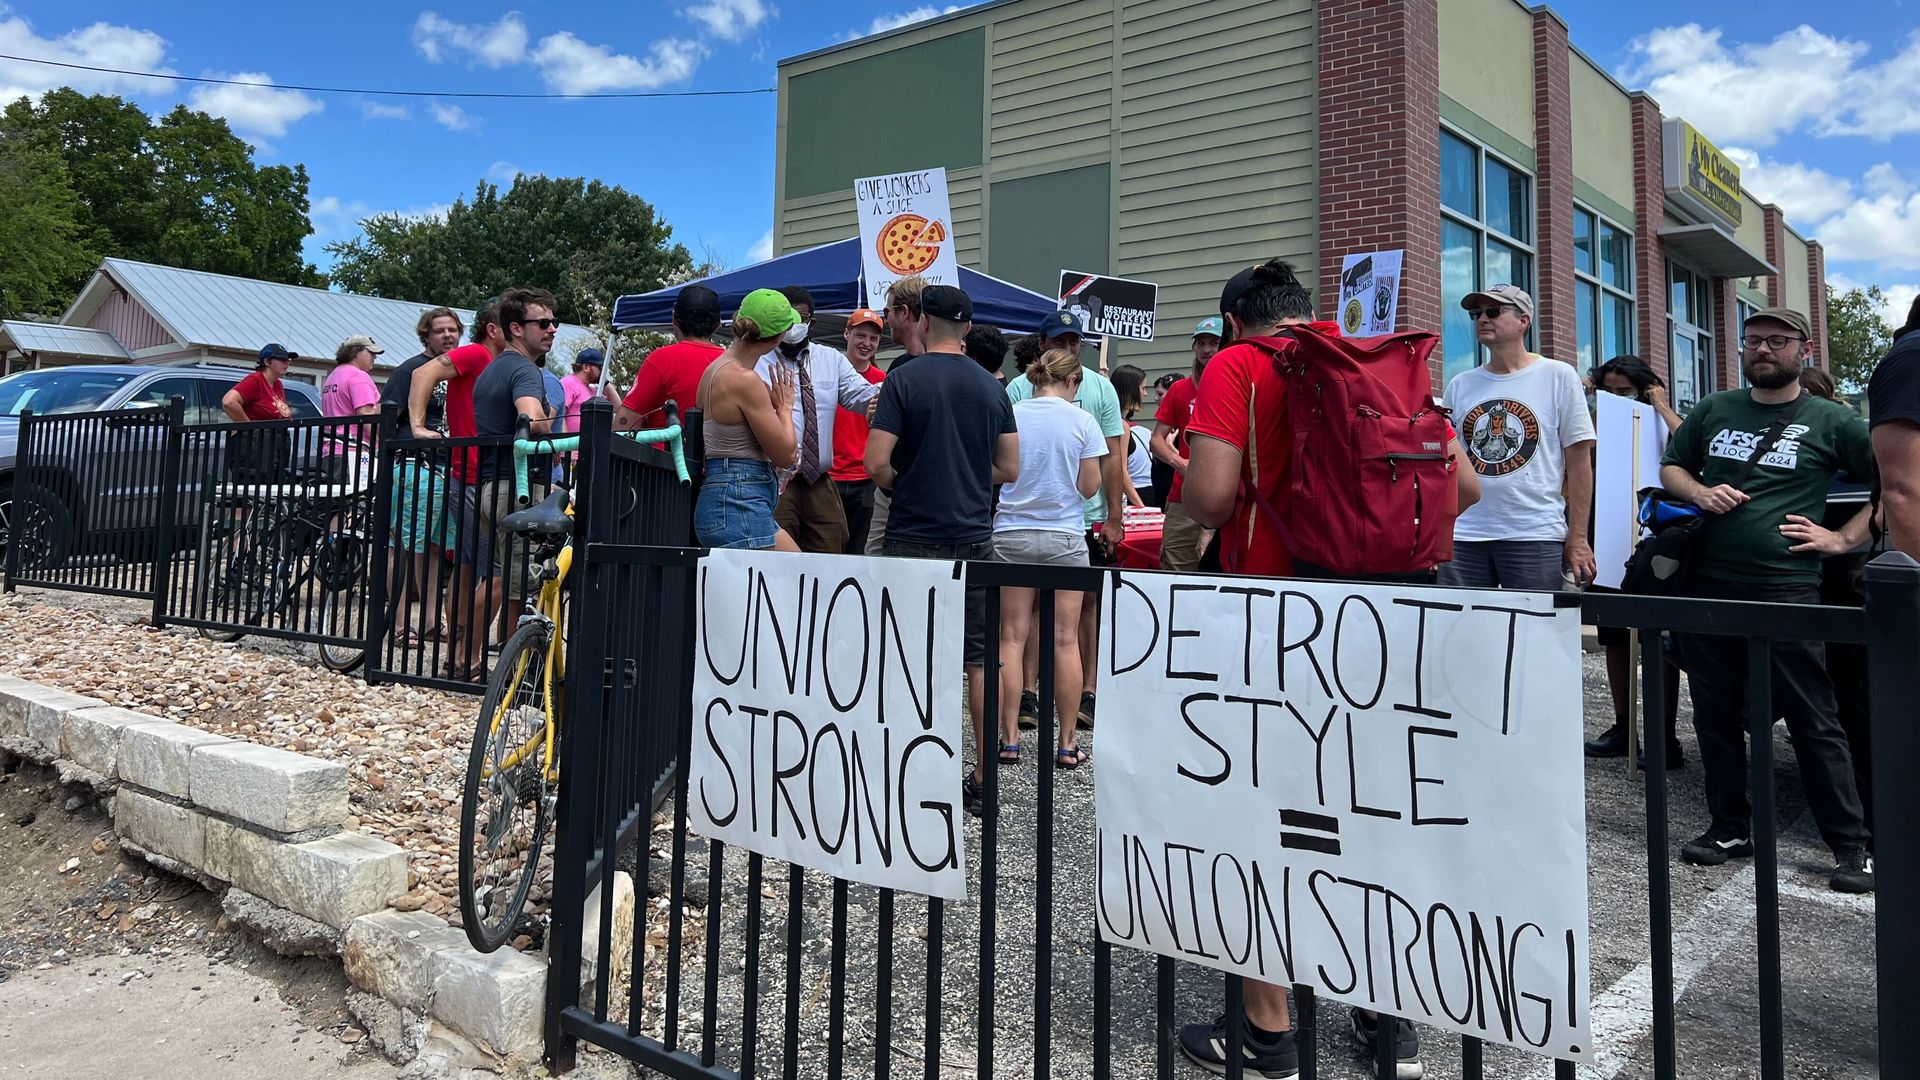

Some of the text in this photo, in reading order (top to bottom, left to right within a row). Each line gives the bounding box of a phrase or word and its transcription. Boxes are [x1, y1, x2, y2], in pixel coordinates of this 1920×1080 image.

[858, 172, 931, 201] GIVE WORKERS
[873, 198, 913, 215] A SLICE
[1104, 305, 1153, 319] RESTAURANT
[1104, 311, 1152, 325] WORKERS
[1095, 317, 1152, 338] UNITED
[1463, 400, 1537, 441] UNION DRIVERS
[1495, 453, 1526, 475] 1549
[1764, 454, 1791, 466] 1624
[702, 565, 937, 731] UNION
[1111, 577, 1556, 735] DETROIT
[1177, 692, 1469, 826] STYLE
[699, 697, 958, 872] STRONG
[1099, 828, 1582, 1053] UNION STRONG!
